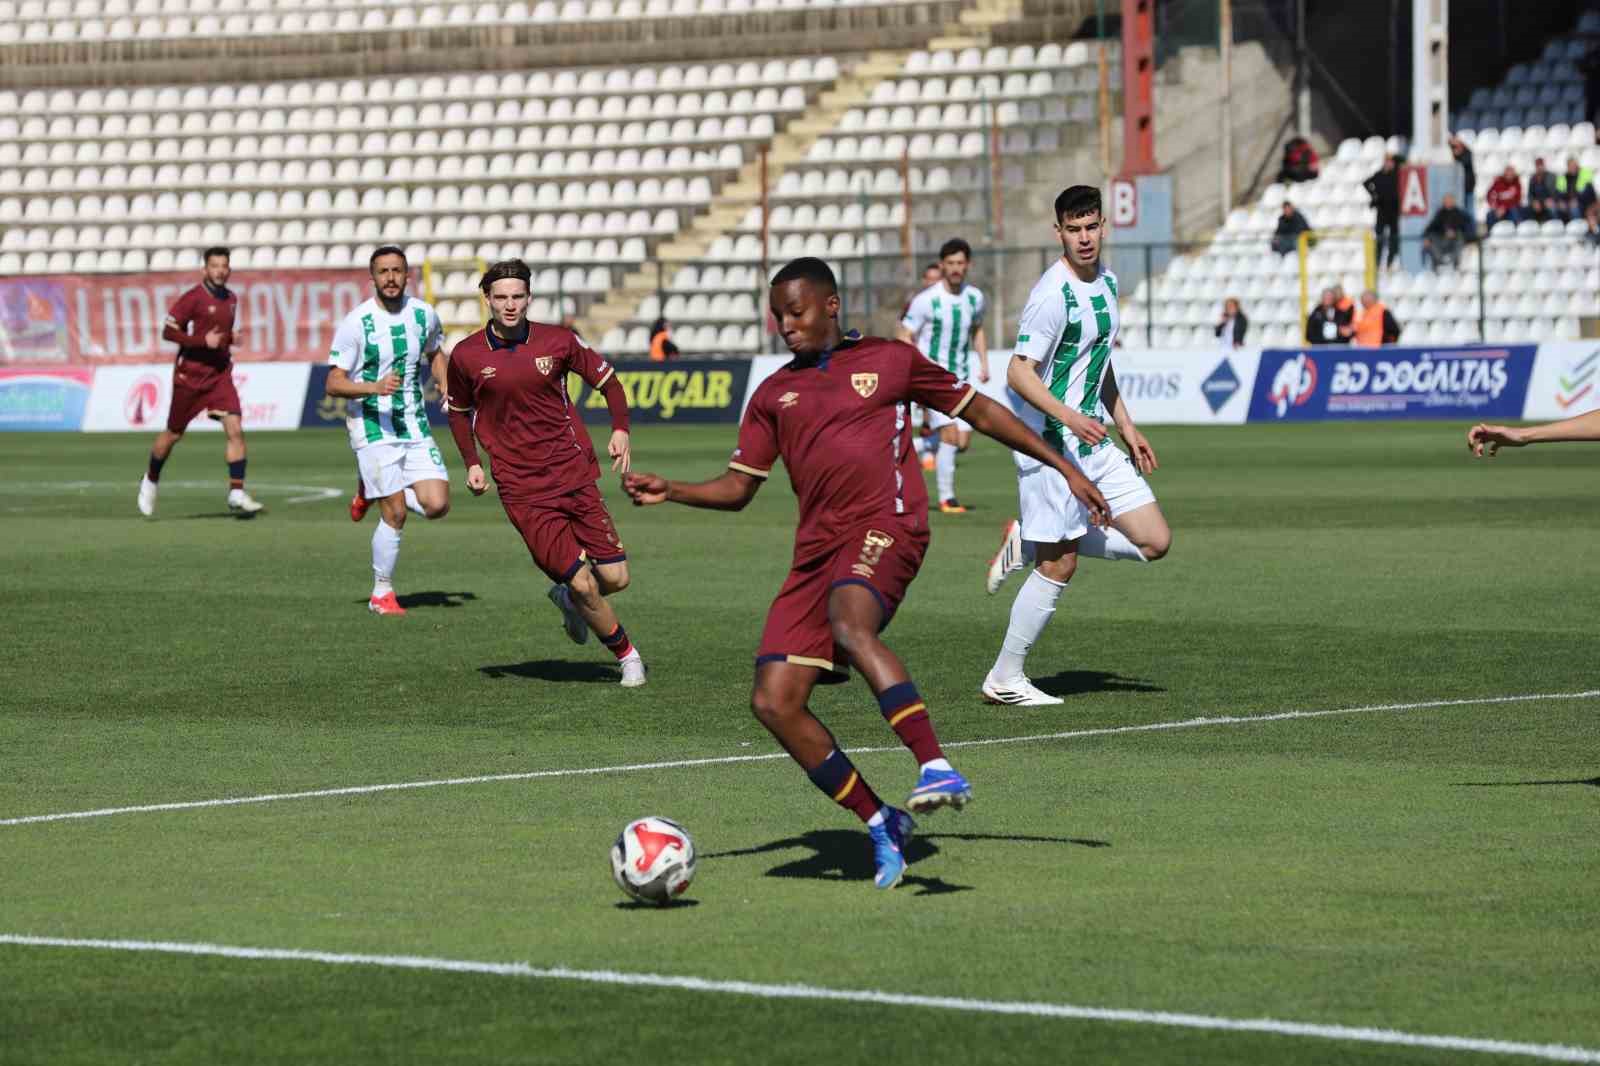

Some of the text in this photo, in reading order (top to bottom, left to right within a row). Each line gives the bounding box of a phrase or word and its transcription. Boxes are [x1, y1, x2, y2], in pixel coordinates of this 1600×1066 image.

[1114, 181, 1135, 223] B
[1402, 169, 1426, 211] A
[75, 284, 196, 357] LiDE
[1119, 371, 1182, 399] mos
[1330, 353, 1508, 399] BD DOĞALTAŞ
